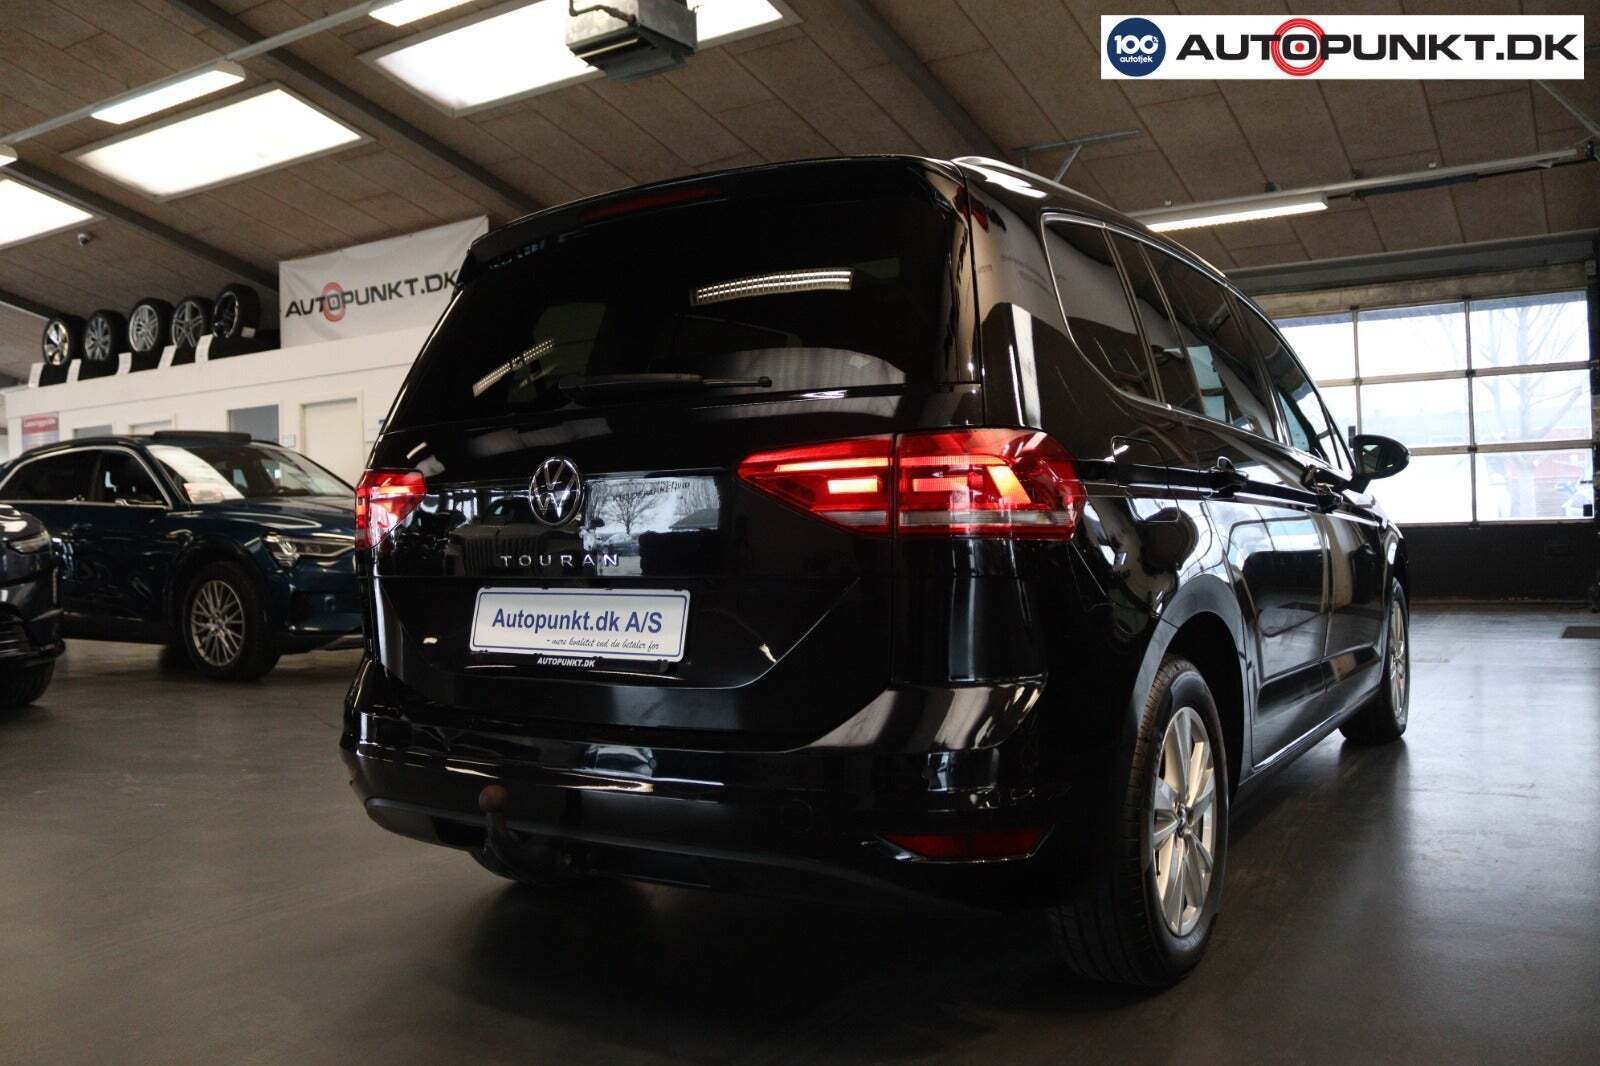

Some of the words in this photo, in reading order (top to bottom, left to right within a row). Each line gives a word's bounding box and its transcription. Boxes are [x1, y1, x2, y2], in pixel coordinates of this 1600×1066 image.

[285, 269, 459, 318] AUTOPUNKT.DK
[501, 554, 621, 568] TOURAN
[492, 608, 621, 634] Autopunkt.dk
[625, 611, 663, 633] A/S
[537, 656, 596, 668] AUTOPUNKT.DK
